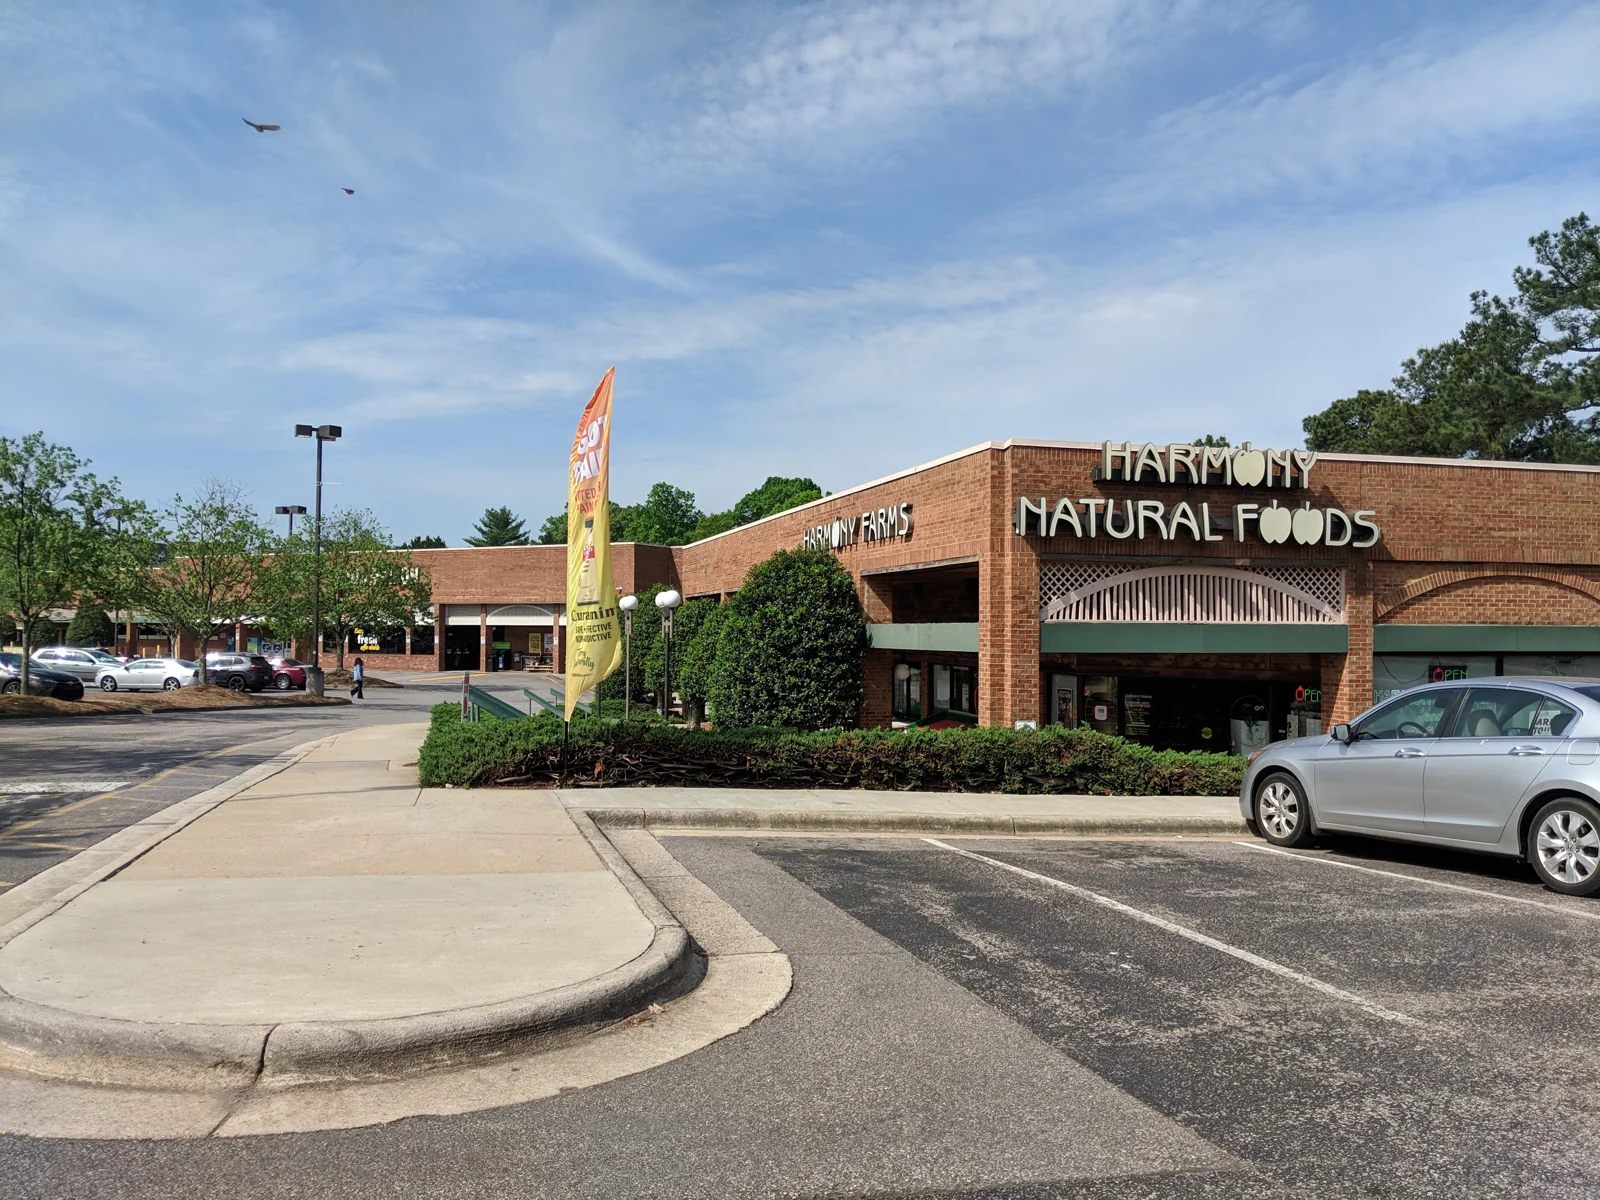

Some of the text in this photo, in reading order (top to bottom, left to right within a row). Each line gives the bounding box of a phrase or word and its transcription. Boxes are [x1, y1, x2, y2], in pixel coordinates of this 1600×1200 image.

[1102, 440, 1317, 489] HARMONY
[803, 502, 913, 550] HARMONY FARMS
[1017, 496, 1380, 548] NATURAL FOODS
[1432, 667, 1468, 682] OPEN
